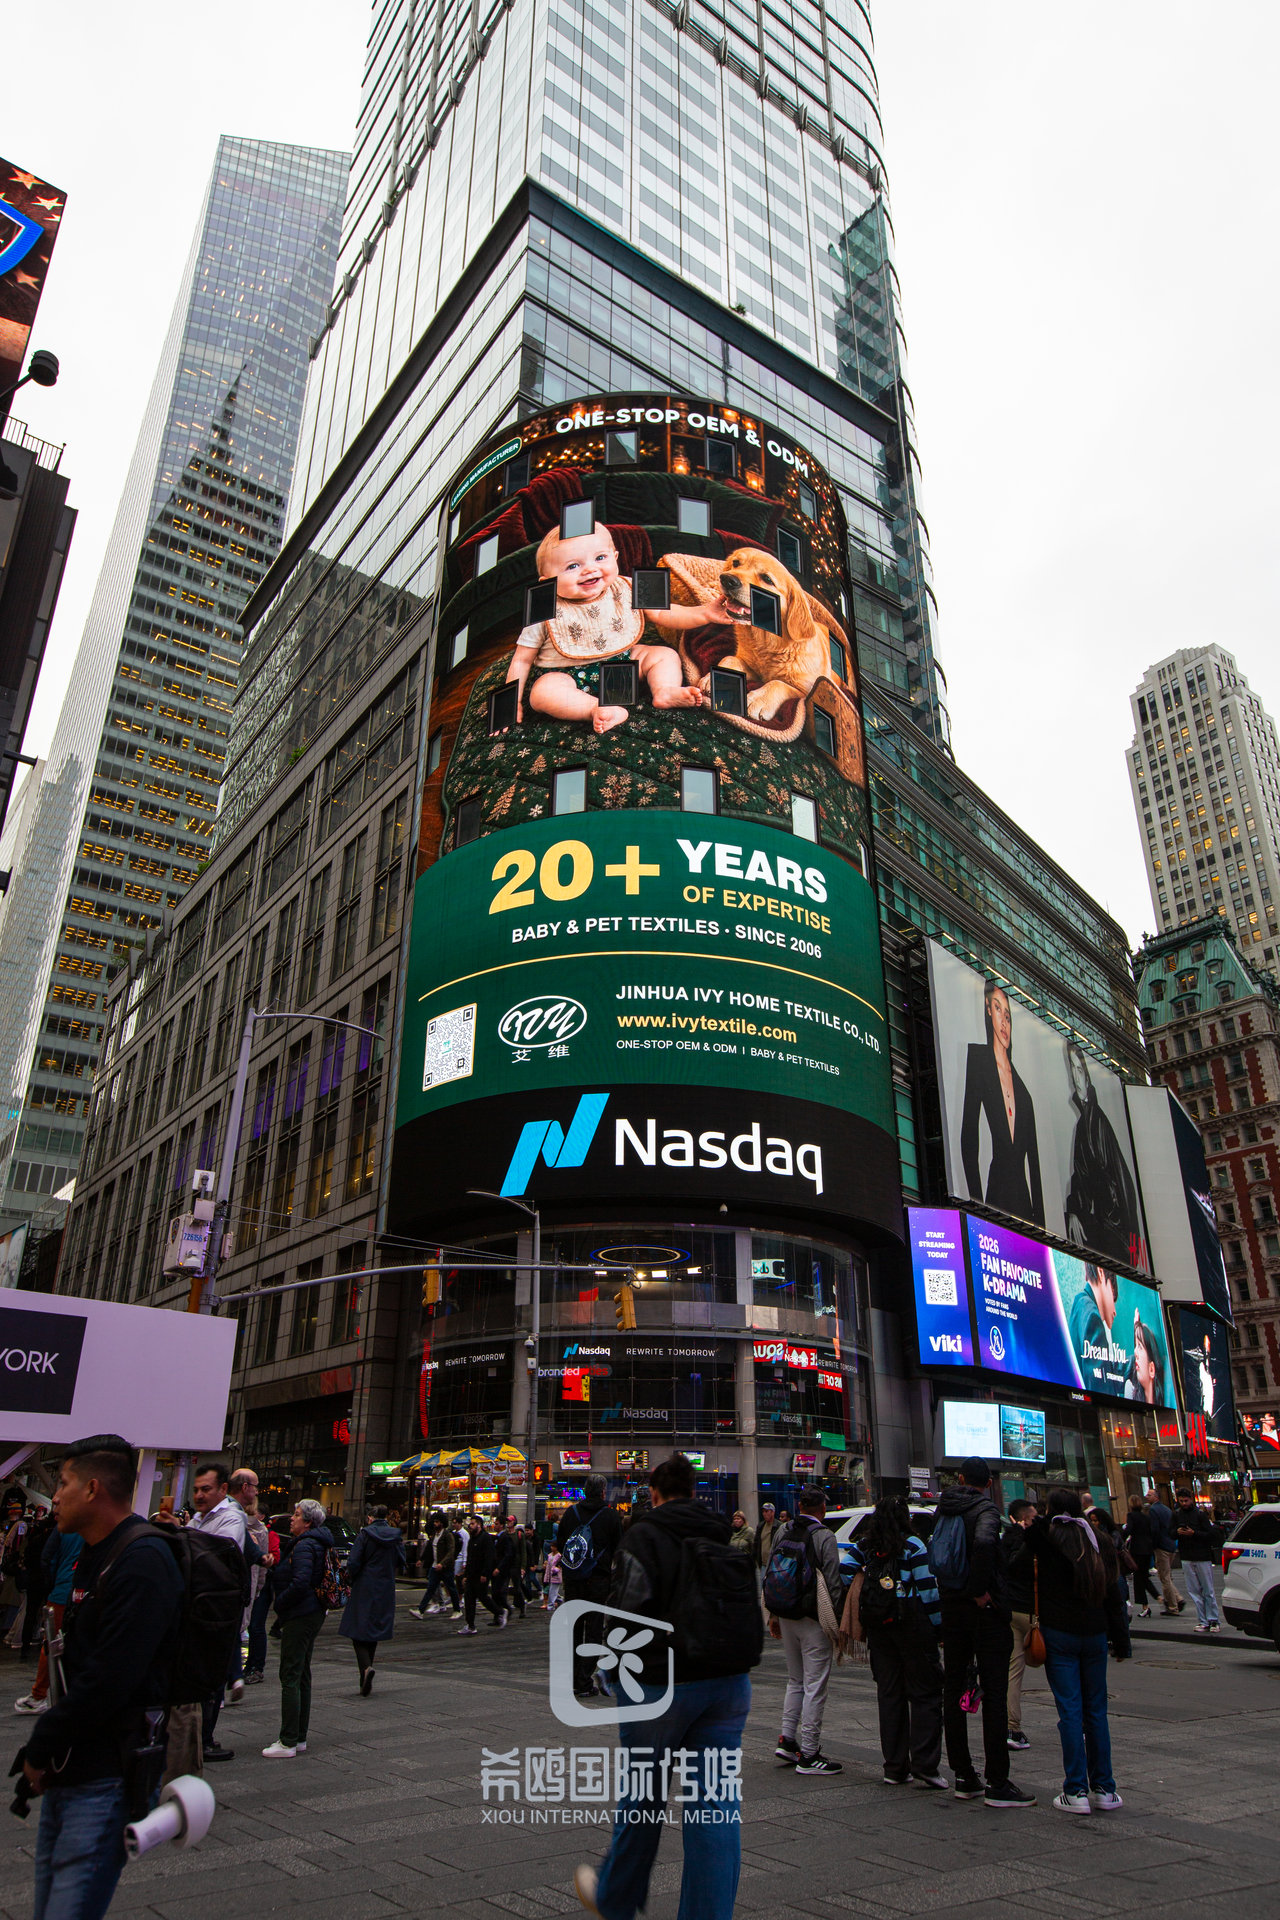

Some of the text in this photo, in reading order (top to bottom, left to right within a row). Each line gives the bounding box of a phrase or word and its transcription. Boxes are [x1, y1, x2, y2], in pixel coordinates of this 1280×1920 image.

[555, 408, 809, 478] ONE-STOP OEM & ODM
[469, 443, 519, 483] MANUFACTURER
[676, 839, 828, 903] YEARS
[683, 885, 832, 935] OF EXPERTISE
[512, 916, 822, 960] BABY & PET TEXTILES SINCE 2006
[615, 985, 882, 1054] JINHUA IVY HOME TEXTILE CO., LTD.
[617, 1012, 798, 1044] www.ivytextile.com
[616, 1040, 840, 1076] ONE-STOP OEM & ODM BABY & PET TEXTILES
[614, 1118, 825, 1195] Nasdaq
[918, 1240, 955, 1250] STREAMING
[925, 1231, 946, 1239] START
[978, 1233, 1000, 1255] 2026
[927, 1251, 949, 1259] TODAY
[980, 1252, 1043, 1290] FAN FAVORITE
[982, 1273, 1028, 1304] K-DRAMA
[469, 1352, 506, 1363] TOMORROW
[578, 1346, 716, 1357] Nasdaq REWRITE TOMORROW
[1081, 1339, 1109, 1361] Dream
[623, 1407, 669, 1421] Nasdaq
